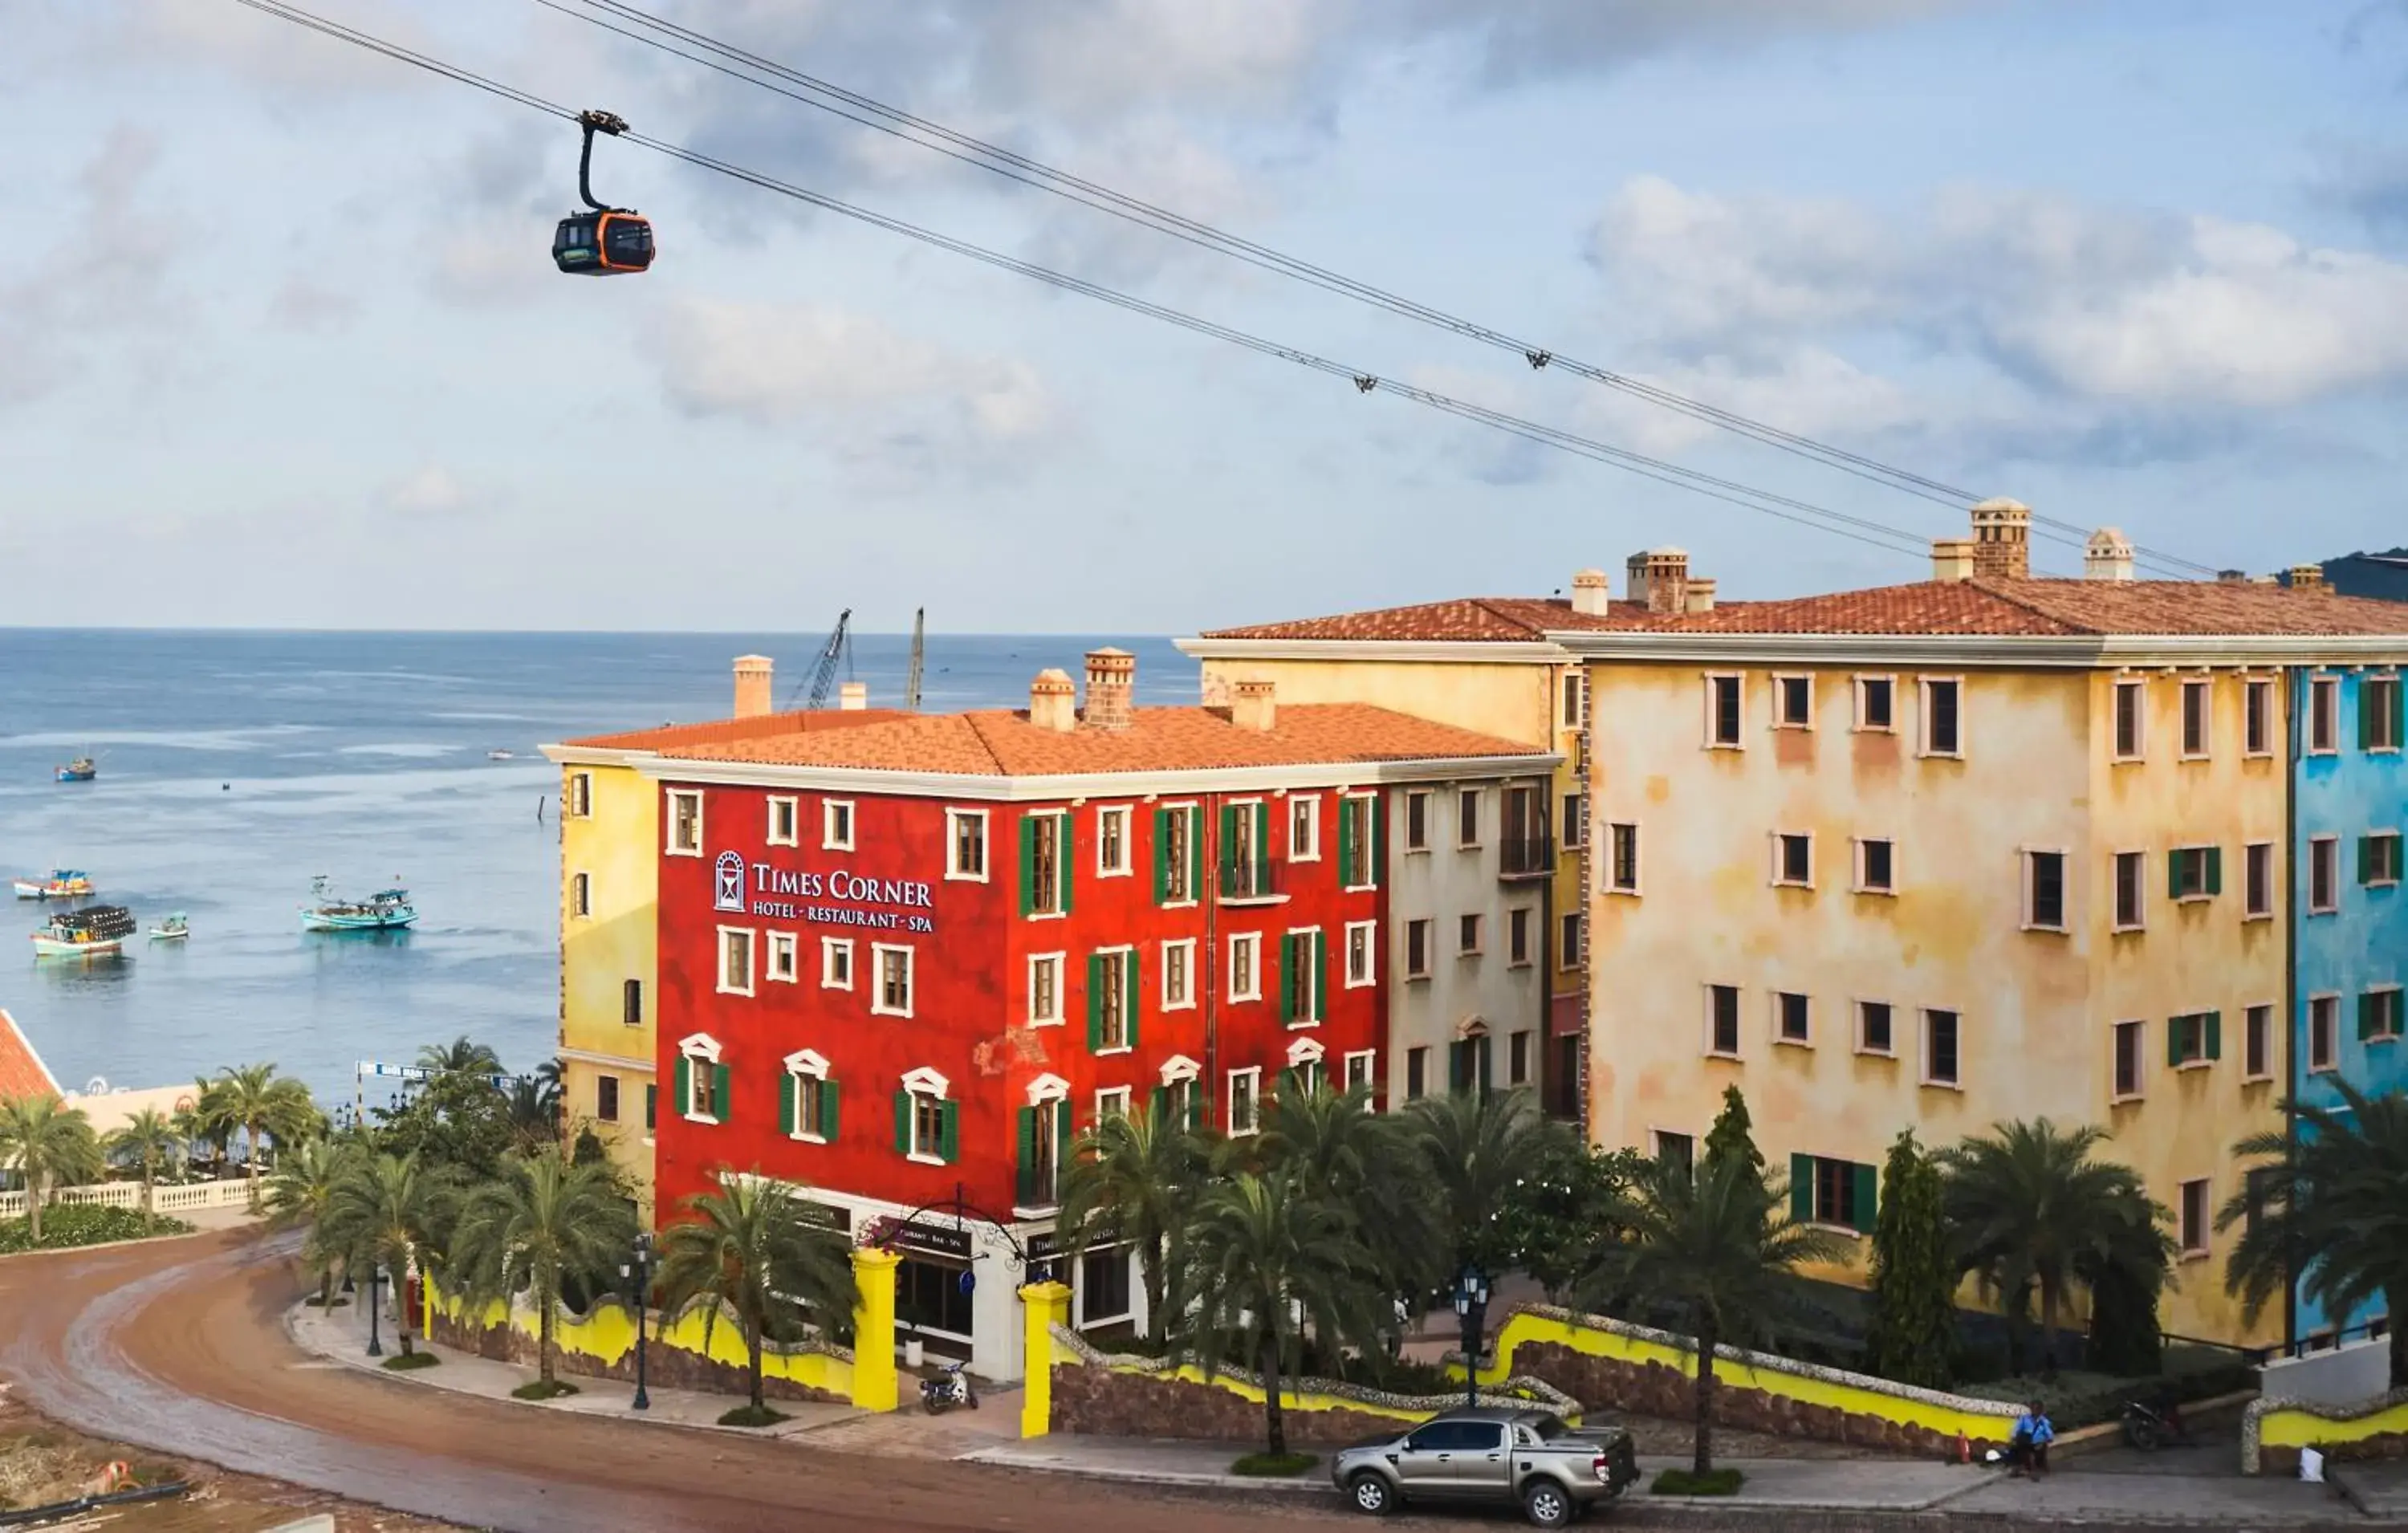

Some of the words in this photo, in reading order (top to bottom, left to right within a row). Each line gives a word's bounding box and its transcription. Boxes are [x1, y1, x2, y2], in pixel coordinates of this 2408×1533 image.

[752, 864, 822, 897] TIMES
[829, 870, 932, 907] CORNER
[753, 901, 796, 918] HOTEL
[808, 906, 897, 928] RESTAURANT
[909, 916, 932, 932] SPA
